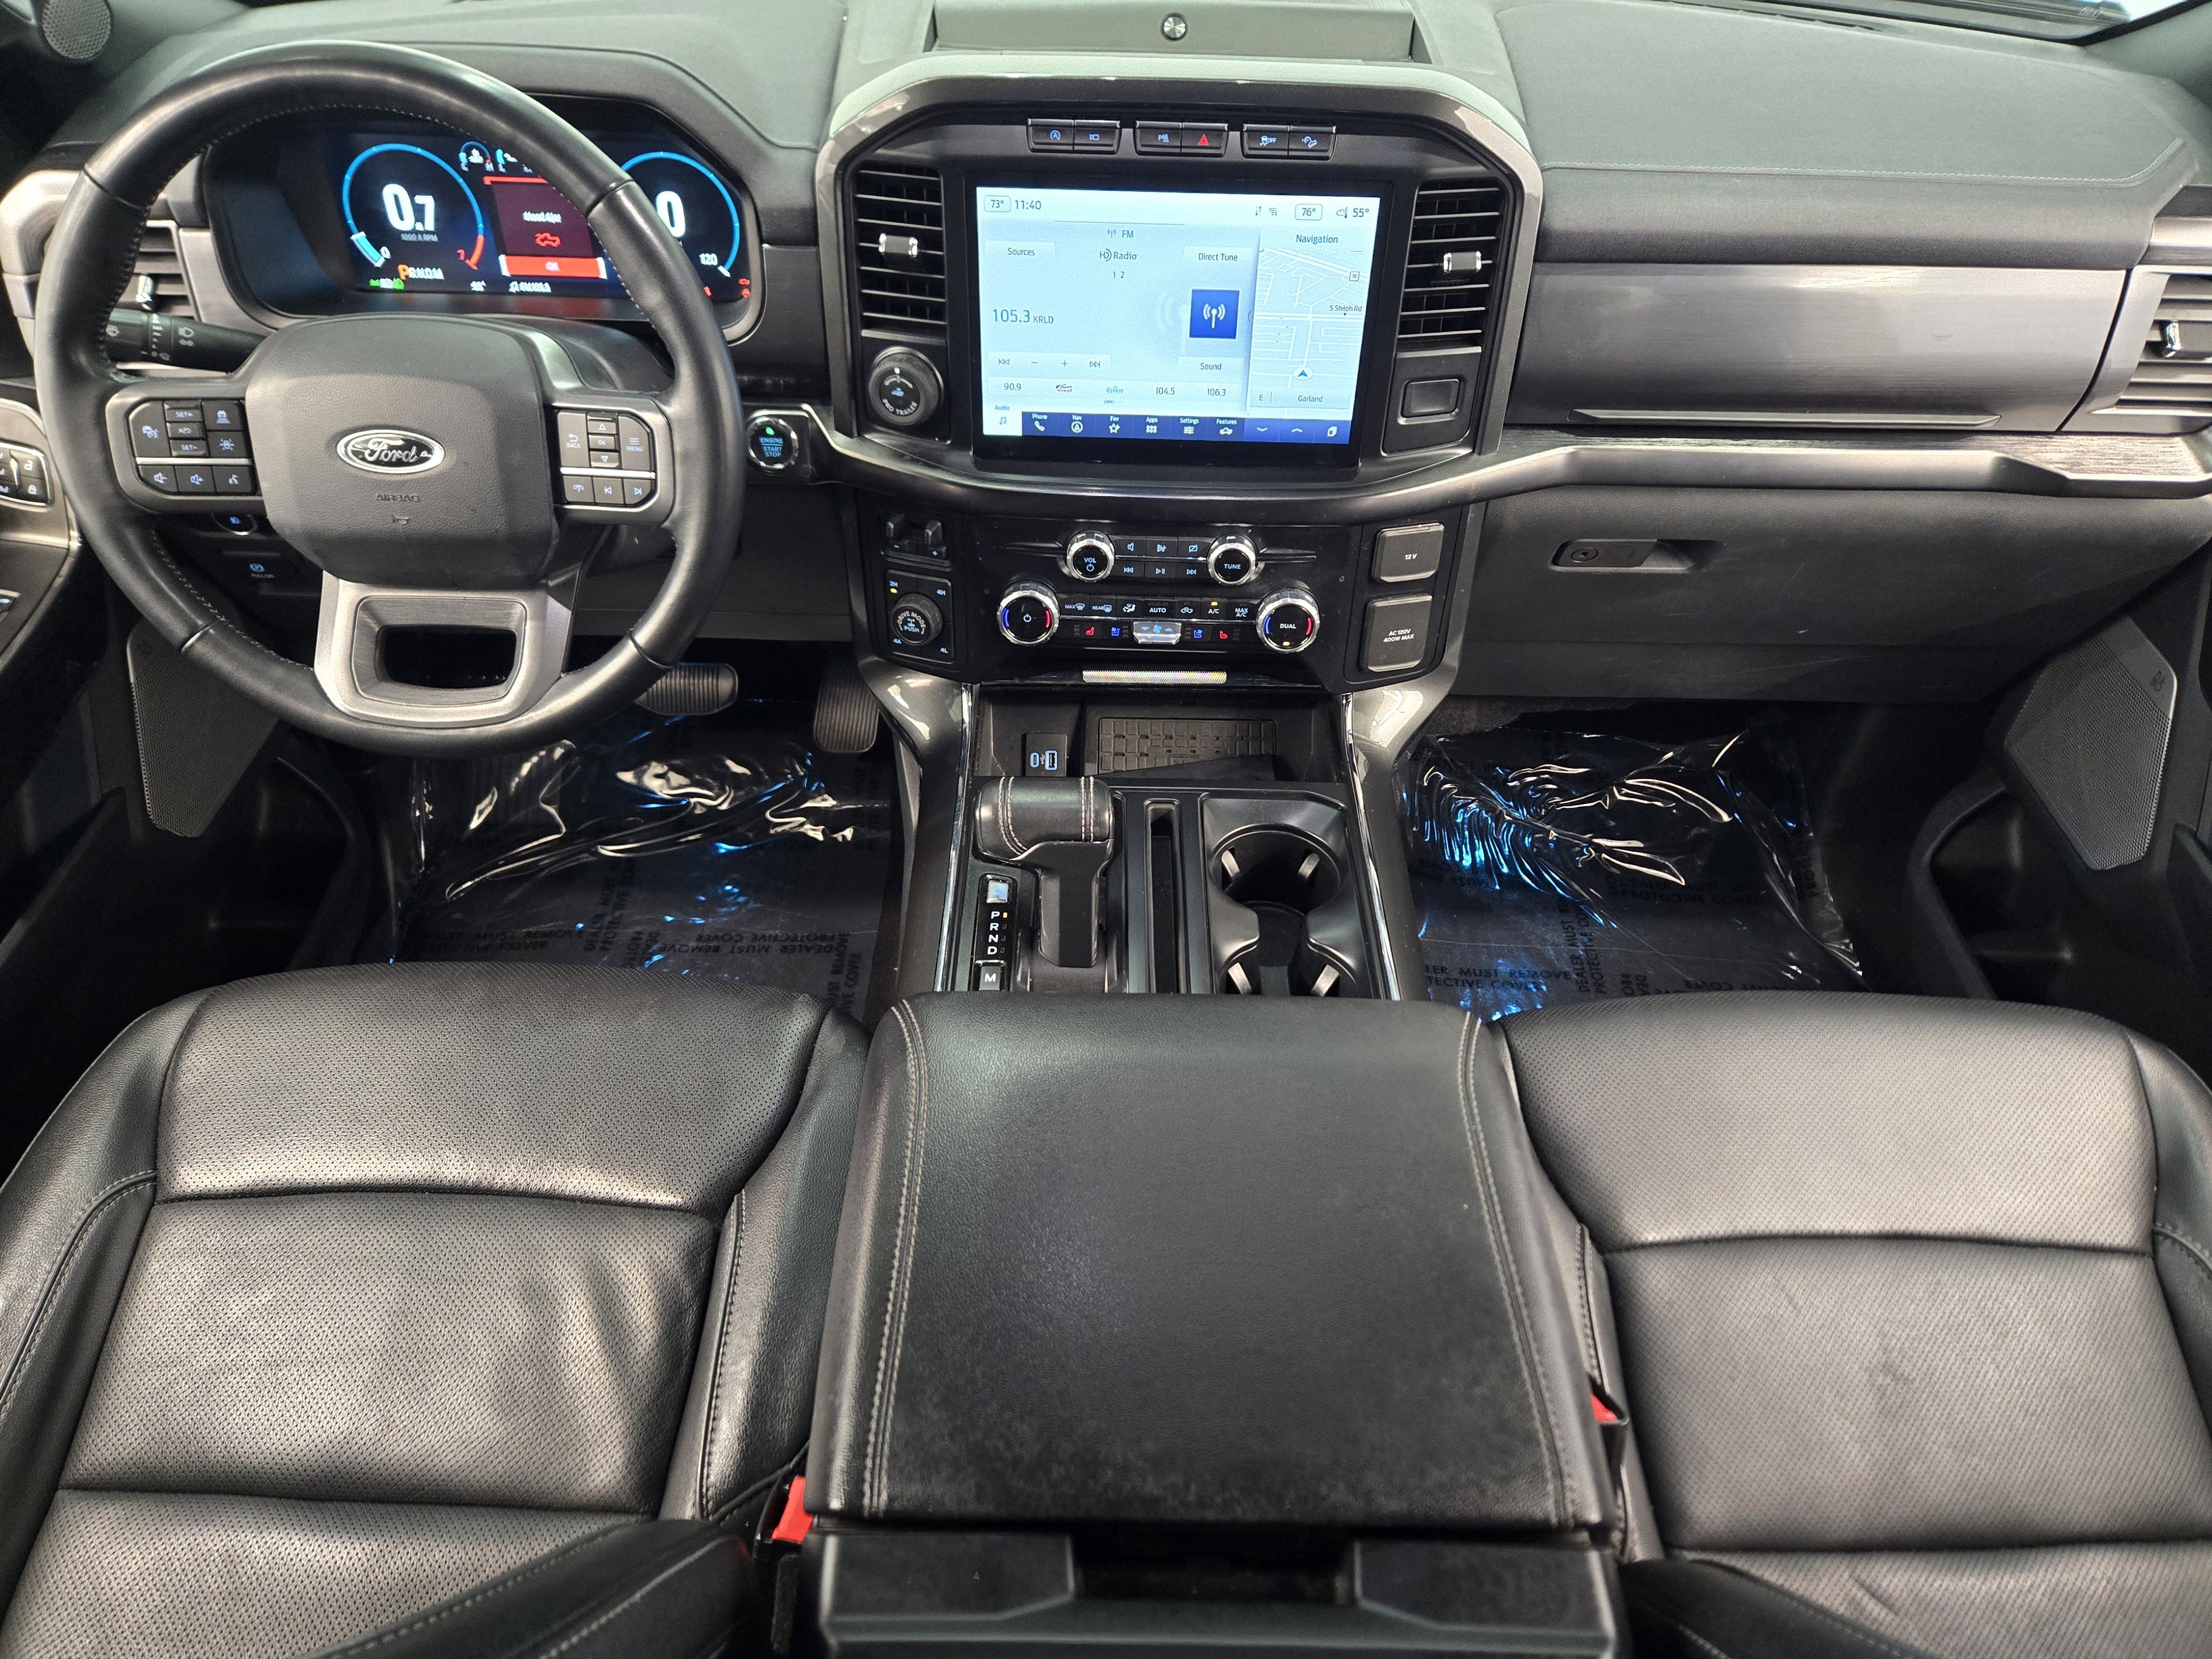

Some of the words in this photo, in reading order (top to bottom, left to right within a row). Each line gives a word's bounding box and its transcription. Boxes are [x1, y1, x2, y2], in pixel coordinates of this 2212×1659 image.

[383, 183, 435, 231] 0.7
[990, 200, 1004, 208] 73°
[1014, 200, 1041, 210] 11:40
[656, 191, 686, 237] 0
[1301, 207, 1316, 216] 76°
[1352, 208, 1369, 217] 55°
[1121, 230, 1134, 238] FM
[1296, 234, 1338, 245] Navigation
[1008, 247, 1035, 256] Sources
[1113, 252, 1137, 260] Radio
[699, 253, 718, 266] 120
[1198, 252, 1219, 262] Direct
[1220, 253, 1238, 262] Tune
[993, 309, 1030, 323] 105.3
[1032, 315, 1054, 324] KRLD
[1200, 362, 1222, 371] Sound
[1004, 383, 1021, 391] 90.9
[1156, 387, 1175, 395] 104.5
[1207, 388, 1226, 397] 106.3
[1298, 395, 1323, 403] Garland
[882, 398, 895, 413] PRO
[895, 401, 918, 416] TRAILER
[364, 437, 419, 462] Ford
[375, 493, 420, 503] AIRBAG
[896, 611, 910, 625] DRIVE
[911, 612, 926, 628] MODE
[991, 911, 1000, 919] P
[989, 922, 999, 931] R
[988, 934, 998, 942] N
[987, 946, 998, 955] D
[985, 973, 997, 982] M
[1459, 967, 1499, 978] MUST
[1509, 969, 1572, 981] REMOVE
[1426, 975, 1483, 989] TECTIVE
